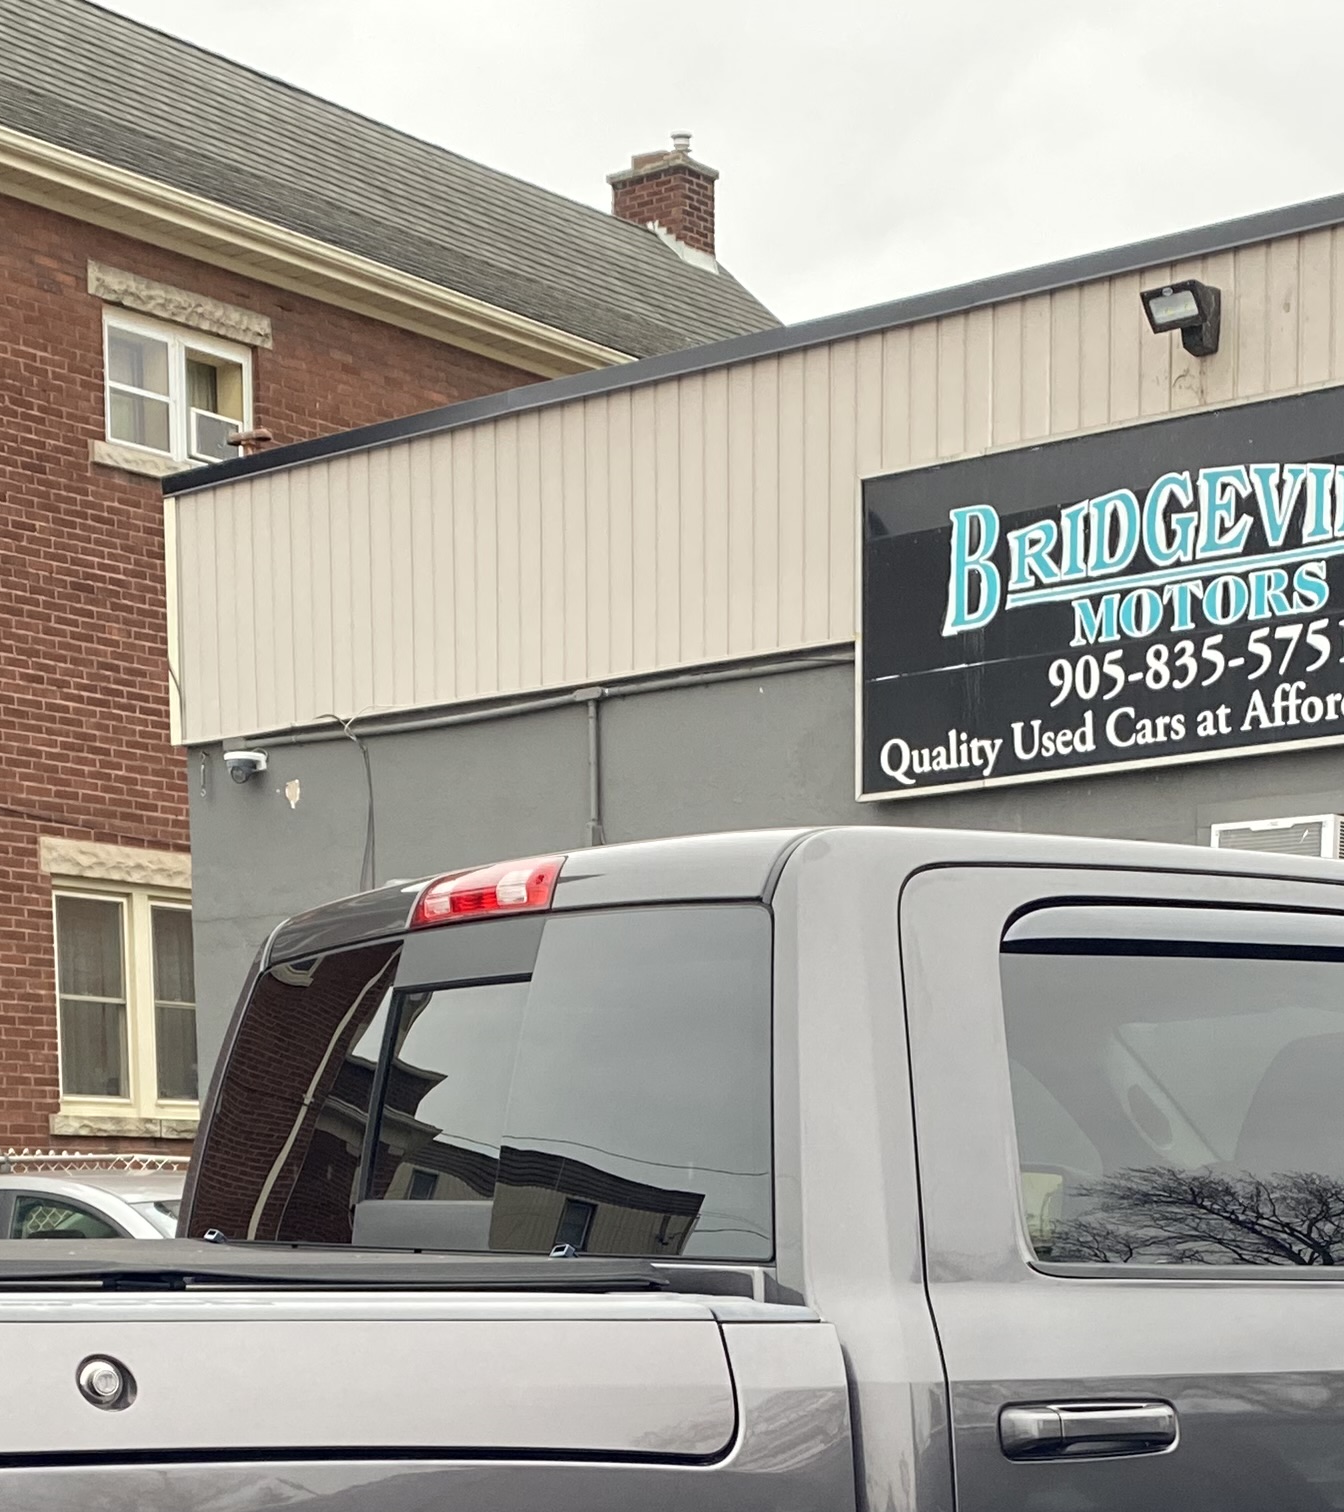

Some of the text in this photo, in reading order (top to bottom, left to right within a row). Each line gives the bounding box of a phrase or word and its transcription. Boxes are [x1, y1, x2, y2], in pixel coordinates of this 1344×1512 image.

[1069, 561, 1329, 647] MOTORS
[880, 729, 1003, 784] Quality
[1011, 710, 1096, 760] Used
[1106, 707, 1186, 748] Cars
[1197, 704, 1232, 737] at
